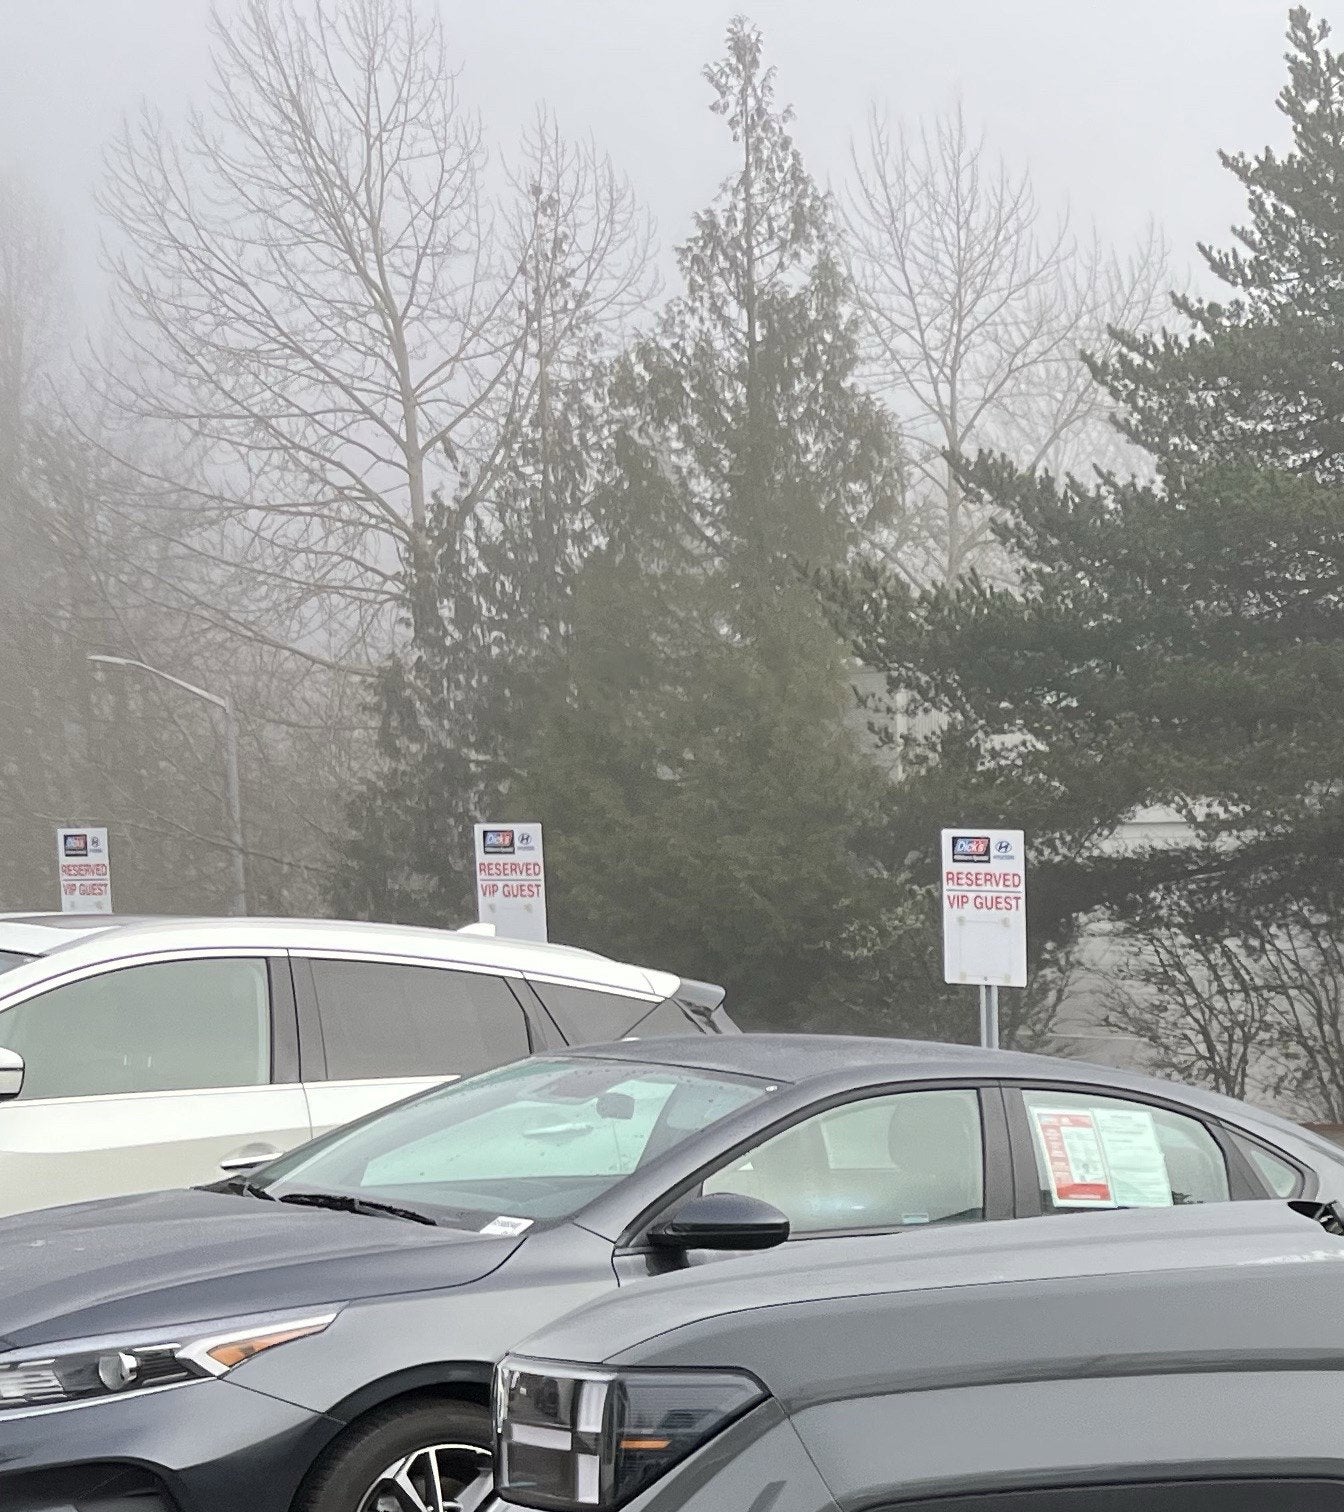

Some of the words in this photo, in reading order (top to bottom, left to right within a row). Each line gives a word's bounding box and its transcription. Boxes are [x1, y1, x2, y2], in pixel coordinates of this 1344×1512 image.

[479, 862, 541, 877] RESERVED
[945, 871, 1022, 888] RESERVED
[480, 884, 499, 898] VIP
[502, 884, 541, 898] GUEST
[947, 894, 969, 910] VIP
[973, 895, 1022, 911] GUEST
